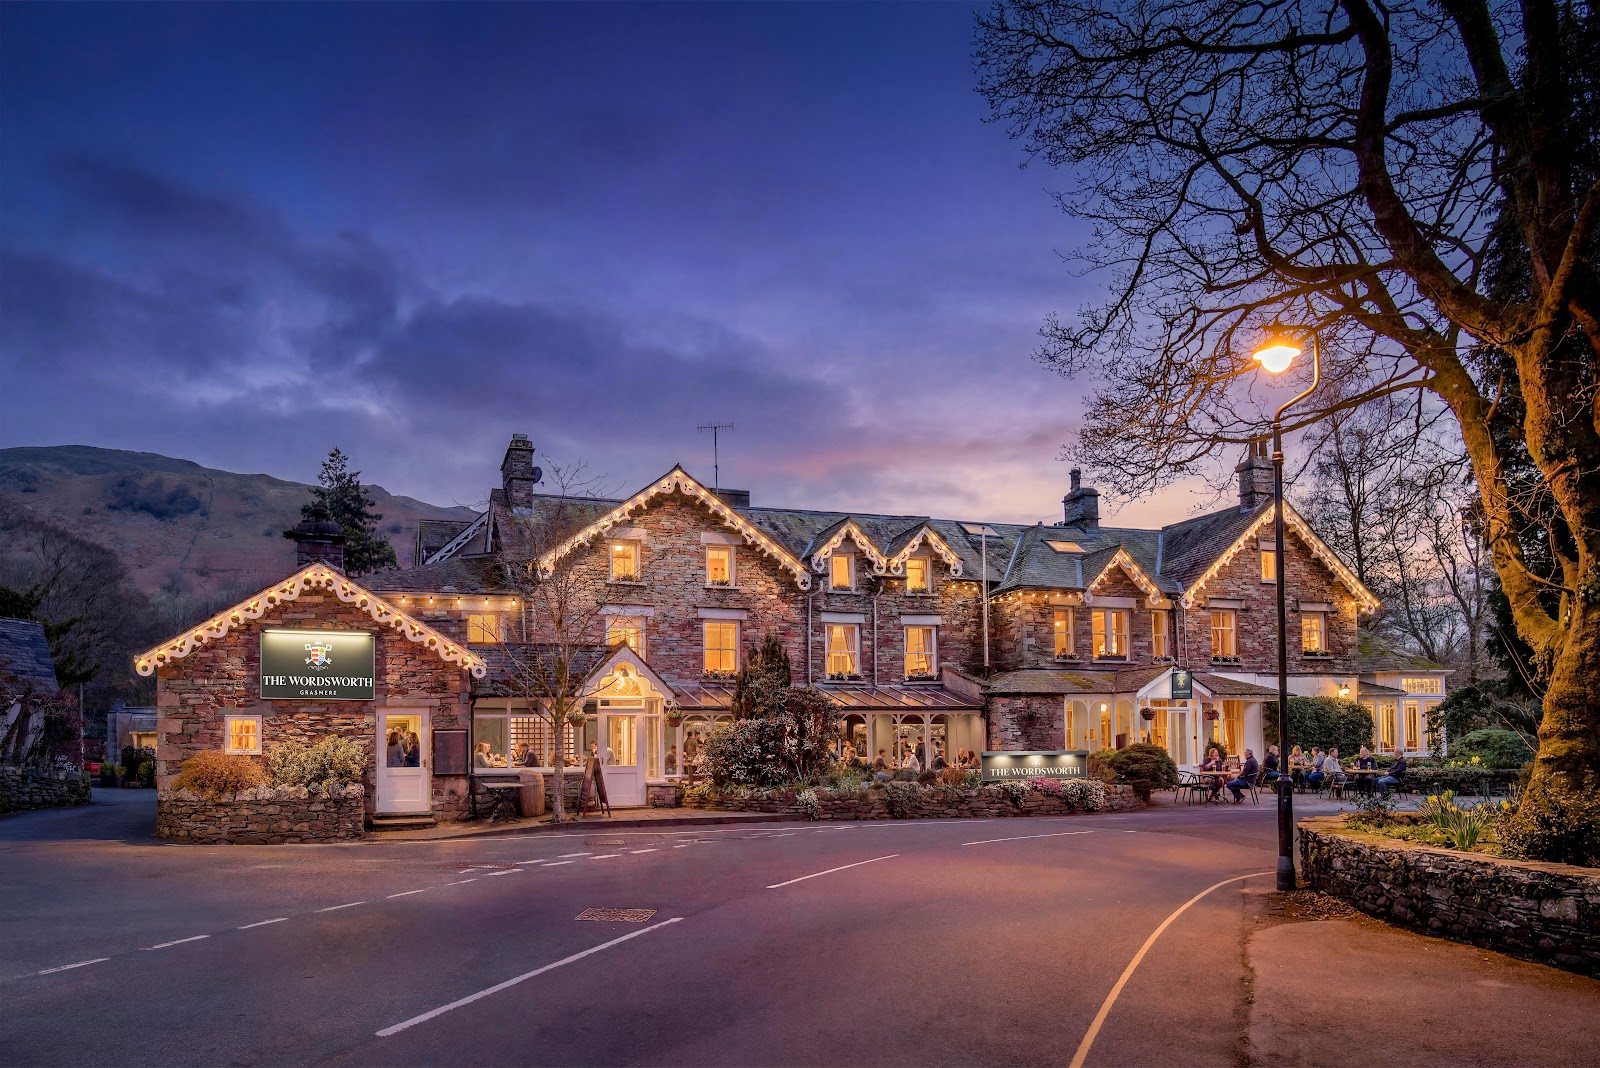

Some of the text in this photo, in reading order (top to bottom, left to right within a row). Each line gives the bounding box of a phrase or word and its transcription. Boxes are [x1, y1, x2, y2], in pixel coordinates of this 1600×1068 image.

[263, 676, 373, 687] THE WORDSWORTH
[1012, 767, 1080, 776] WORDSWORTH
